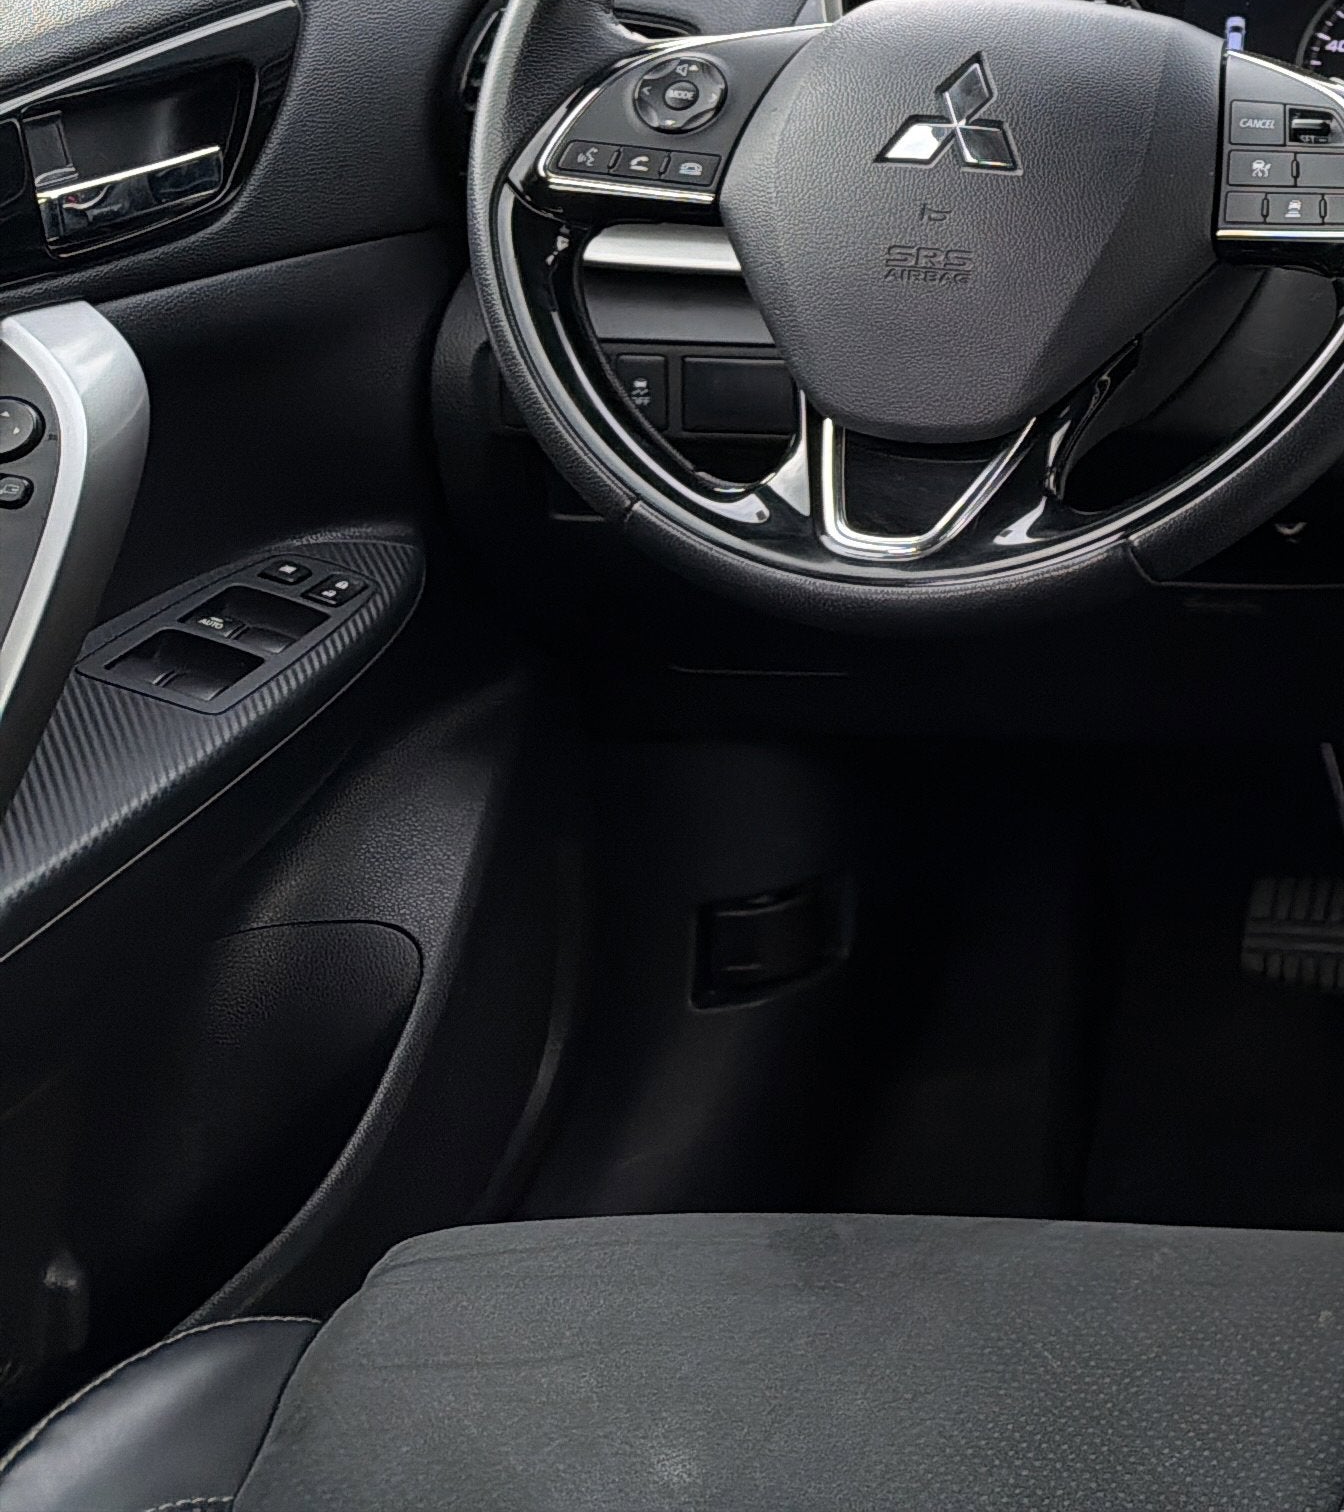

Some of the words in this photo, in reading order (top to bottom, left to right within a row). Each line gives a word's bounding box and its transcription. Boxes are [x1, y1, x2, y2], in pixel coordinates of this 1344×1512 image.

[667, 89, 695, 101] MODE
[1239, 117, 1276, 129] CANCEL
[885, 244, 975, 273] SRS
[884, 267, 973, 285] AIRBAG
[198, 618, 223, 630] AUTO
